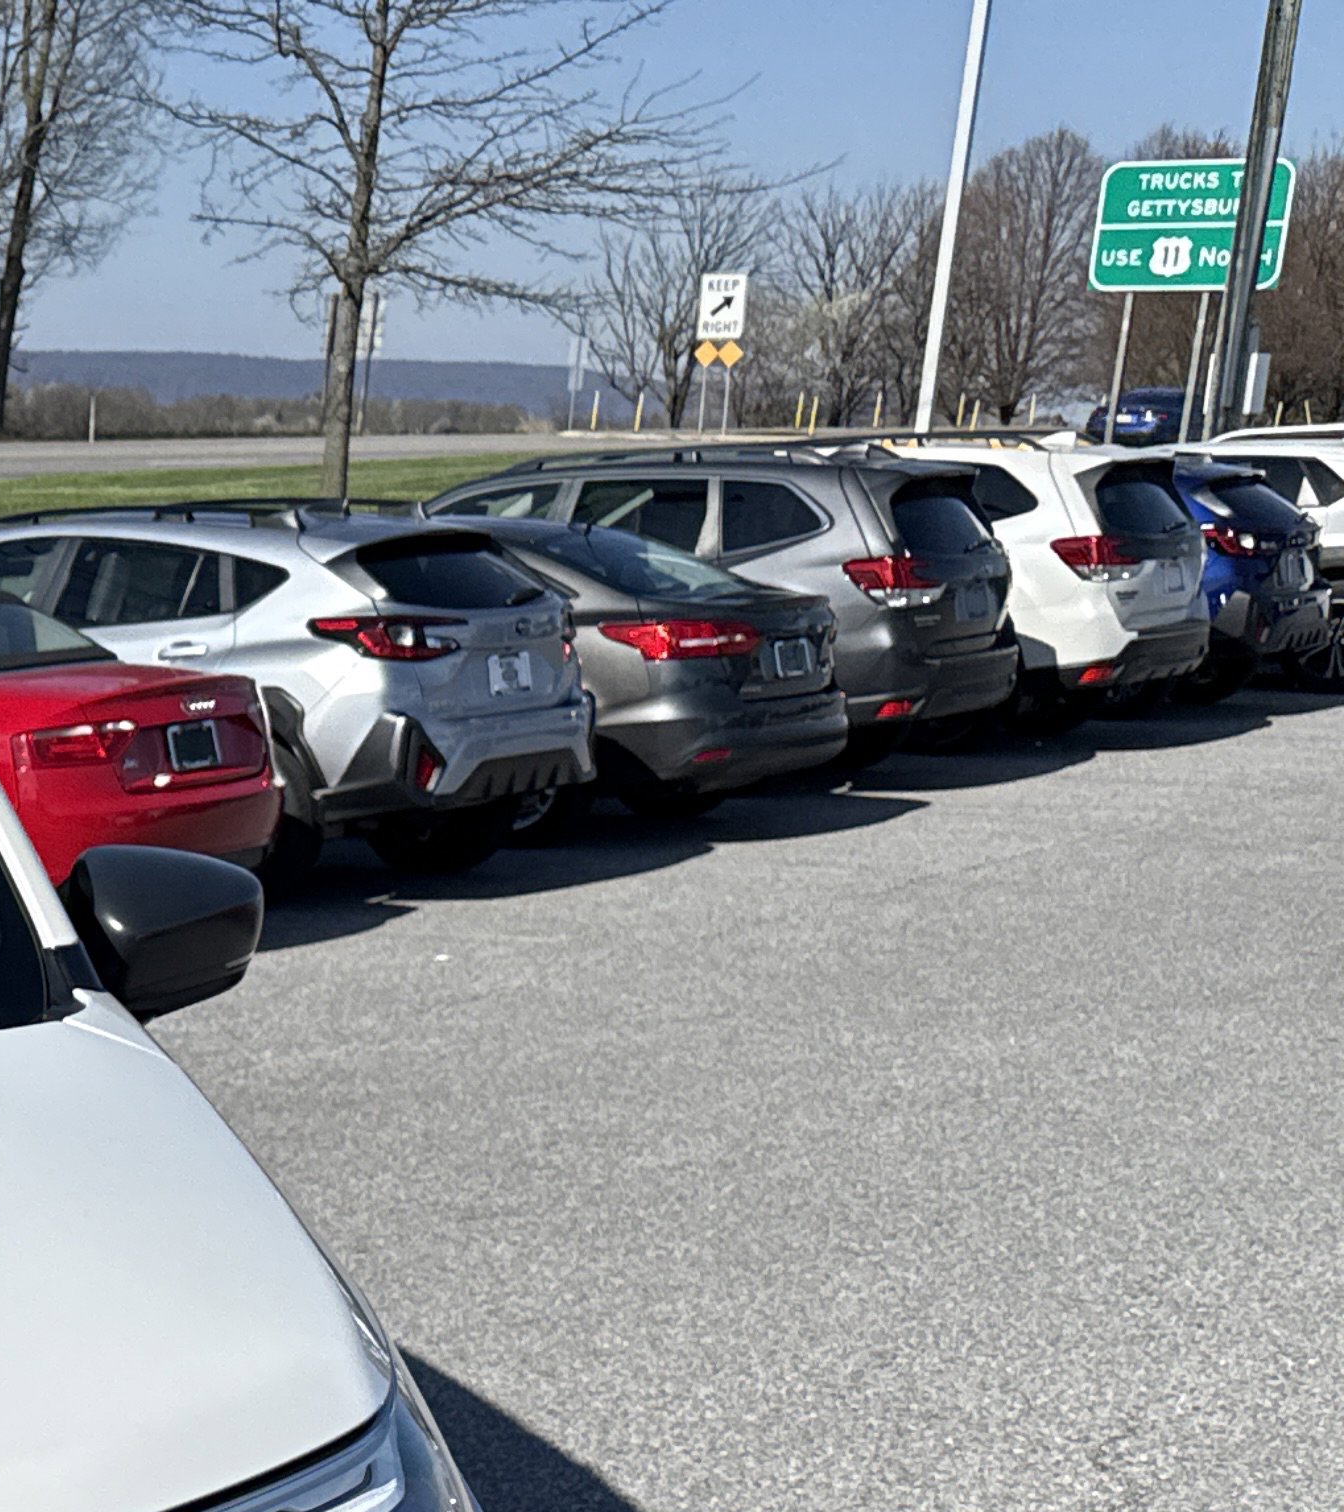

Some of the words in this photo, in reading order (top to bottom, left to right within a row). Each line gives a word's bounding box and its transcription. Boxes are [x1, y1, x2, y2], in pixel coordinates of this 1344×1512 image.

[1139, 171, 1220, 190] TRUCKS
[1127, 198, 1241, 217] GETTYSBU
[1101, 248, 1143, 266] USE
[1162, 245, 1181, 268] 11
[707, 279, 741, 292] KEEP
[702, 320, 739, 333] RIGHT
